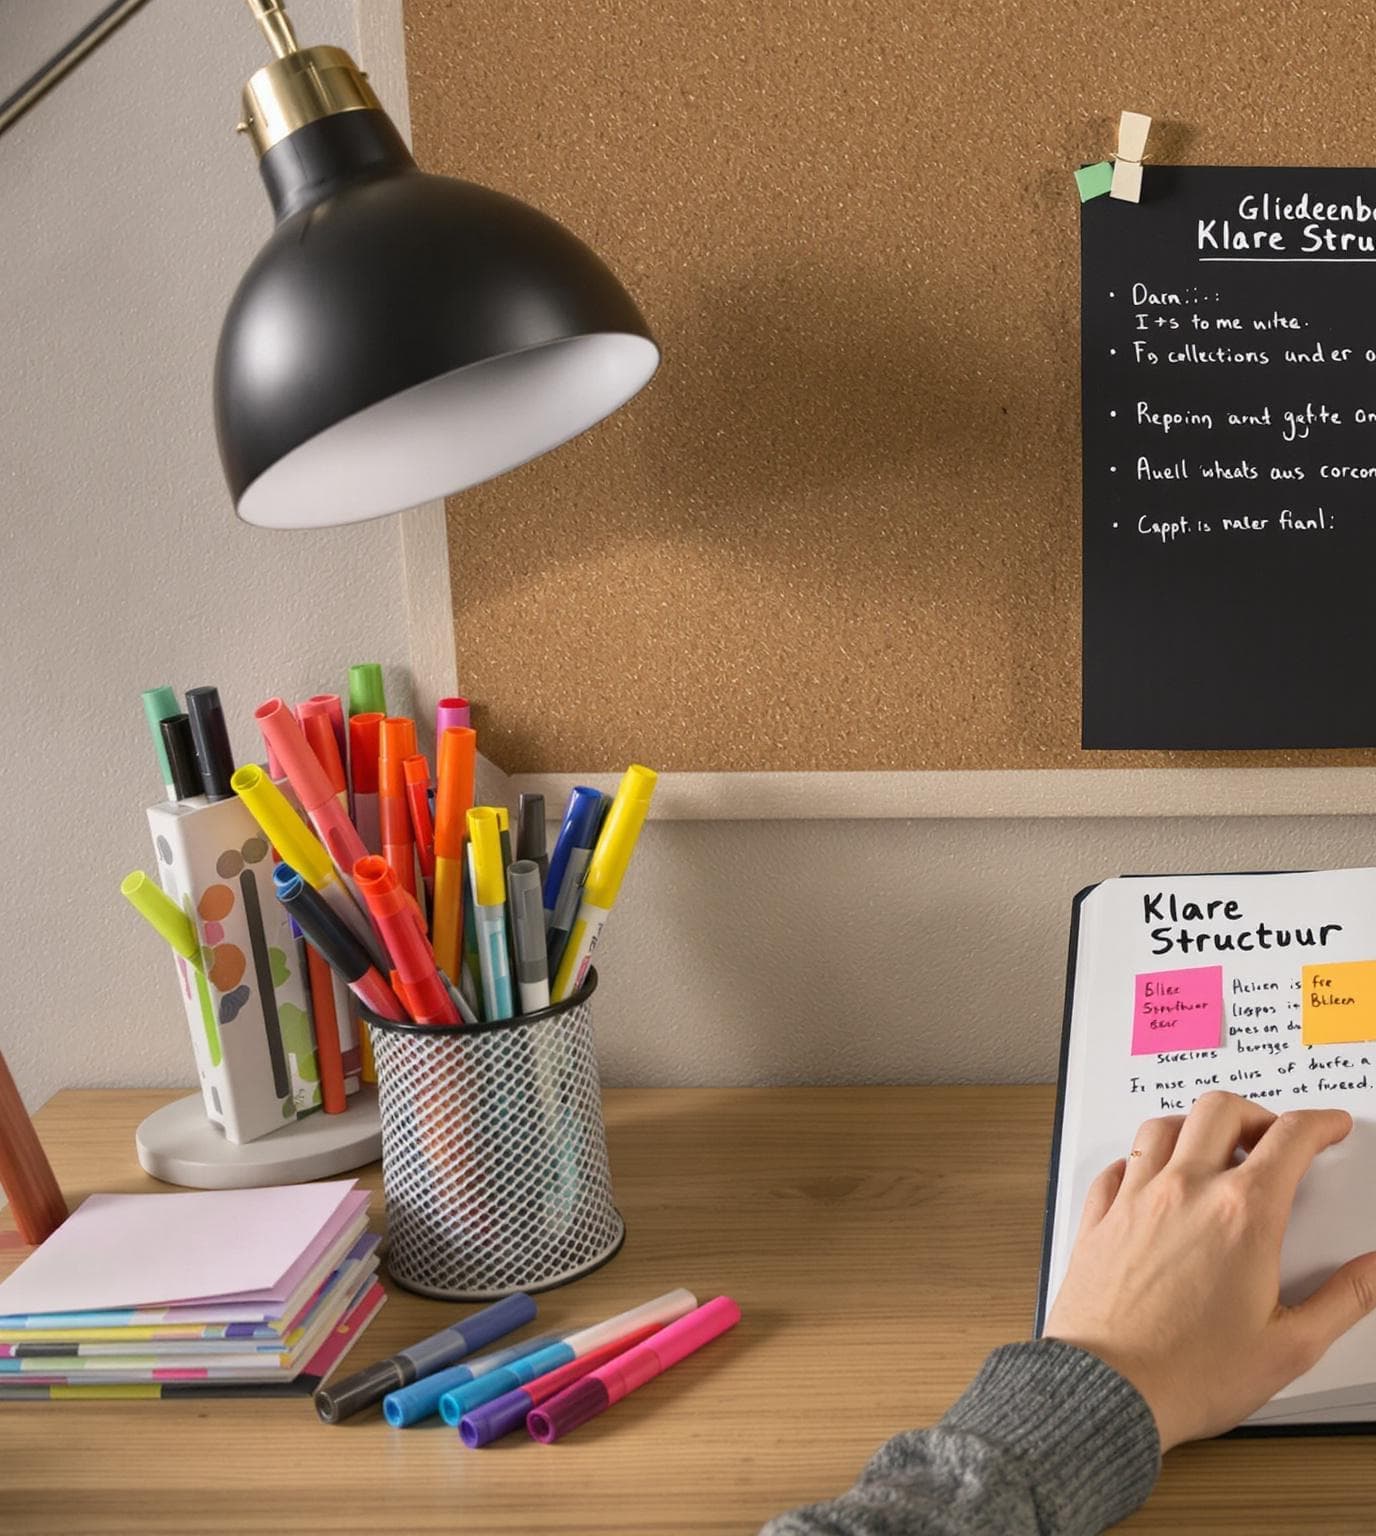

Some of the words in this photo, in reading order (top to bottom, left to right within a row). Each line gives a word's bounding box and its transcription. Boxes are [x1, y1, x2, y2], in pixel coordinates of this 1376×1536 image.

[1198, 219, 1285, 250] Klare
[1143, 892, 1243, 924] Klare
[1151, 923, 1343, 955] Structuur
